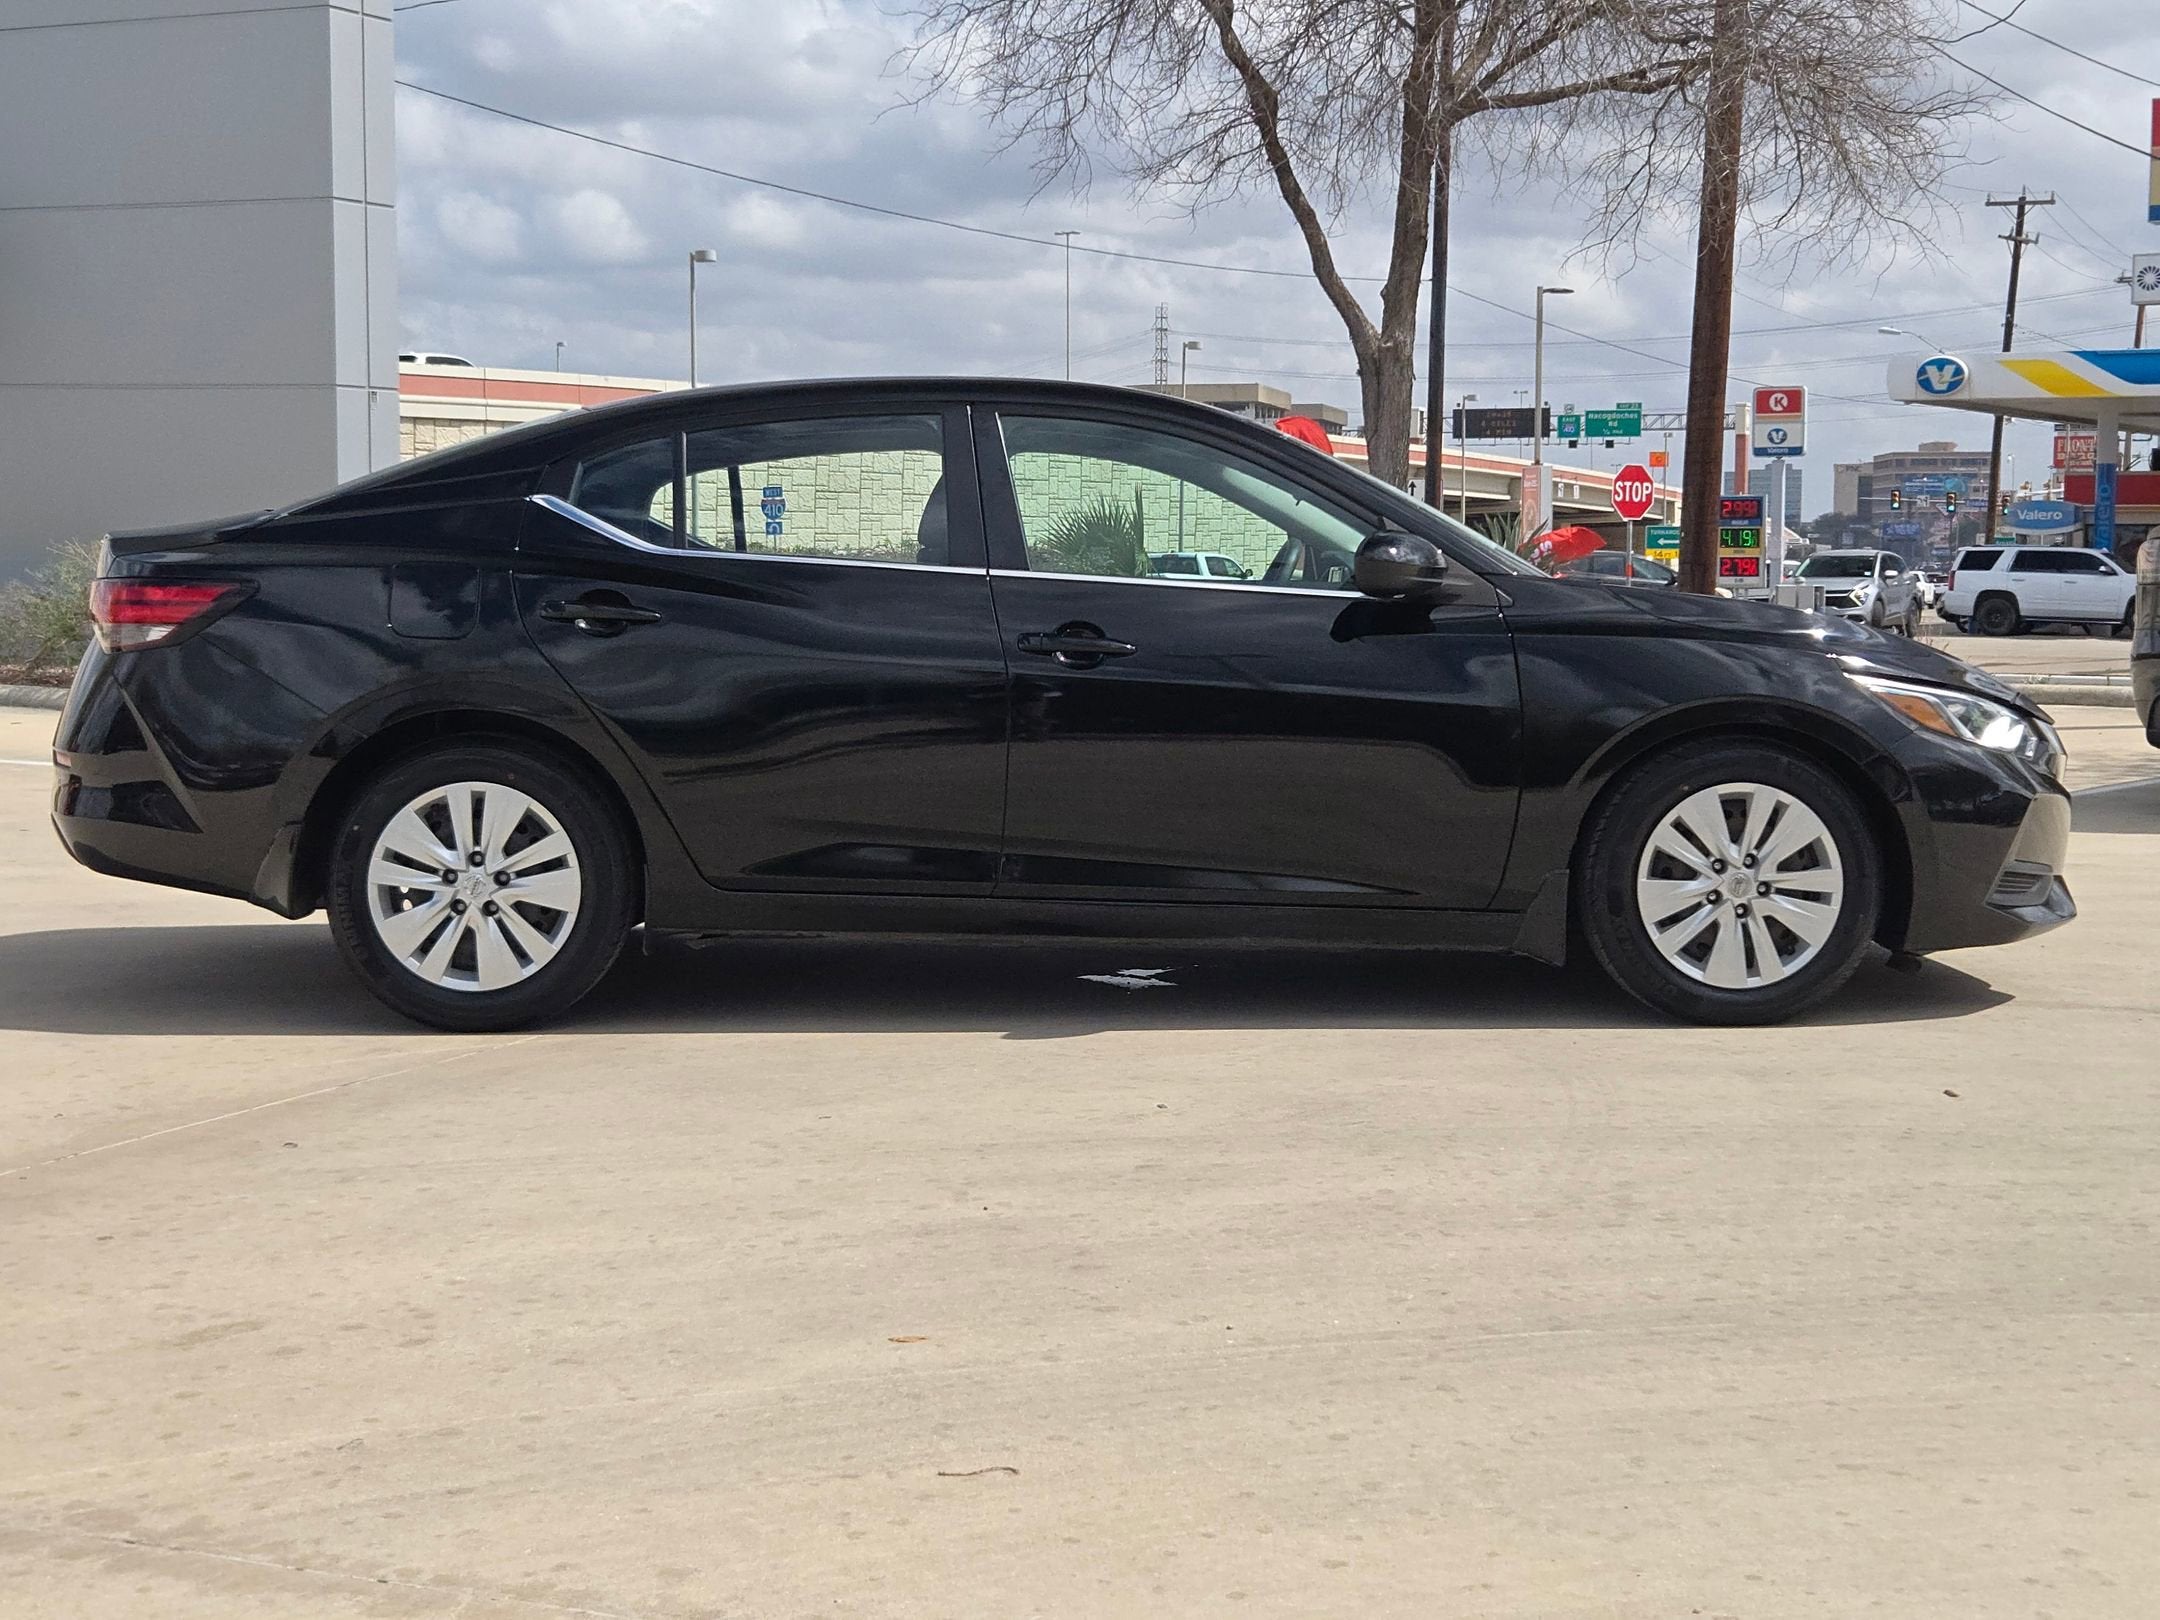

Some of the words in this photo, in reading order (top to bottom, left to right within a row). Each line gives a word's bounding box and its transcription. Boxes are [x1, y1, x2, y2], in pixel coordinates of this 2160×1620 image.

[1588, 412, 1638, 420] Nacogdoches
[1614, 481, 1652, 502] STOP
[764, 504, 784, 516] 410
[2016, 509, 2063, 521] Valero
